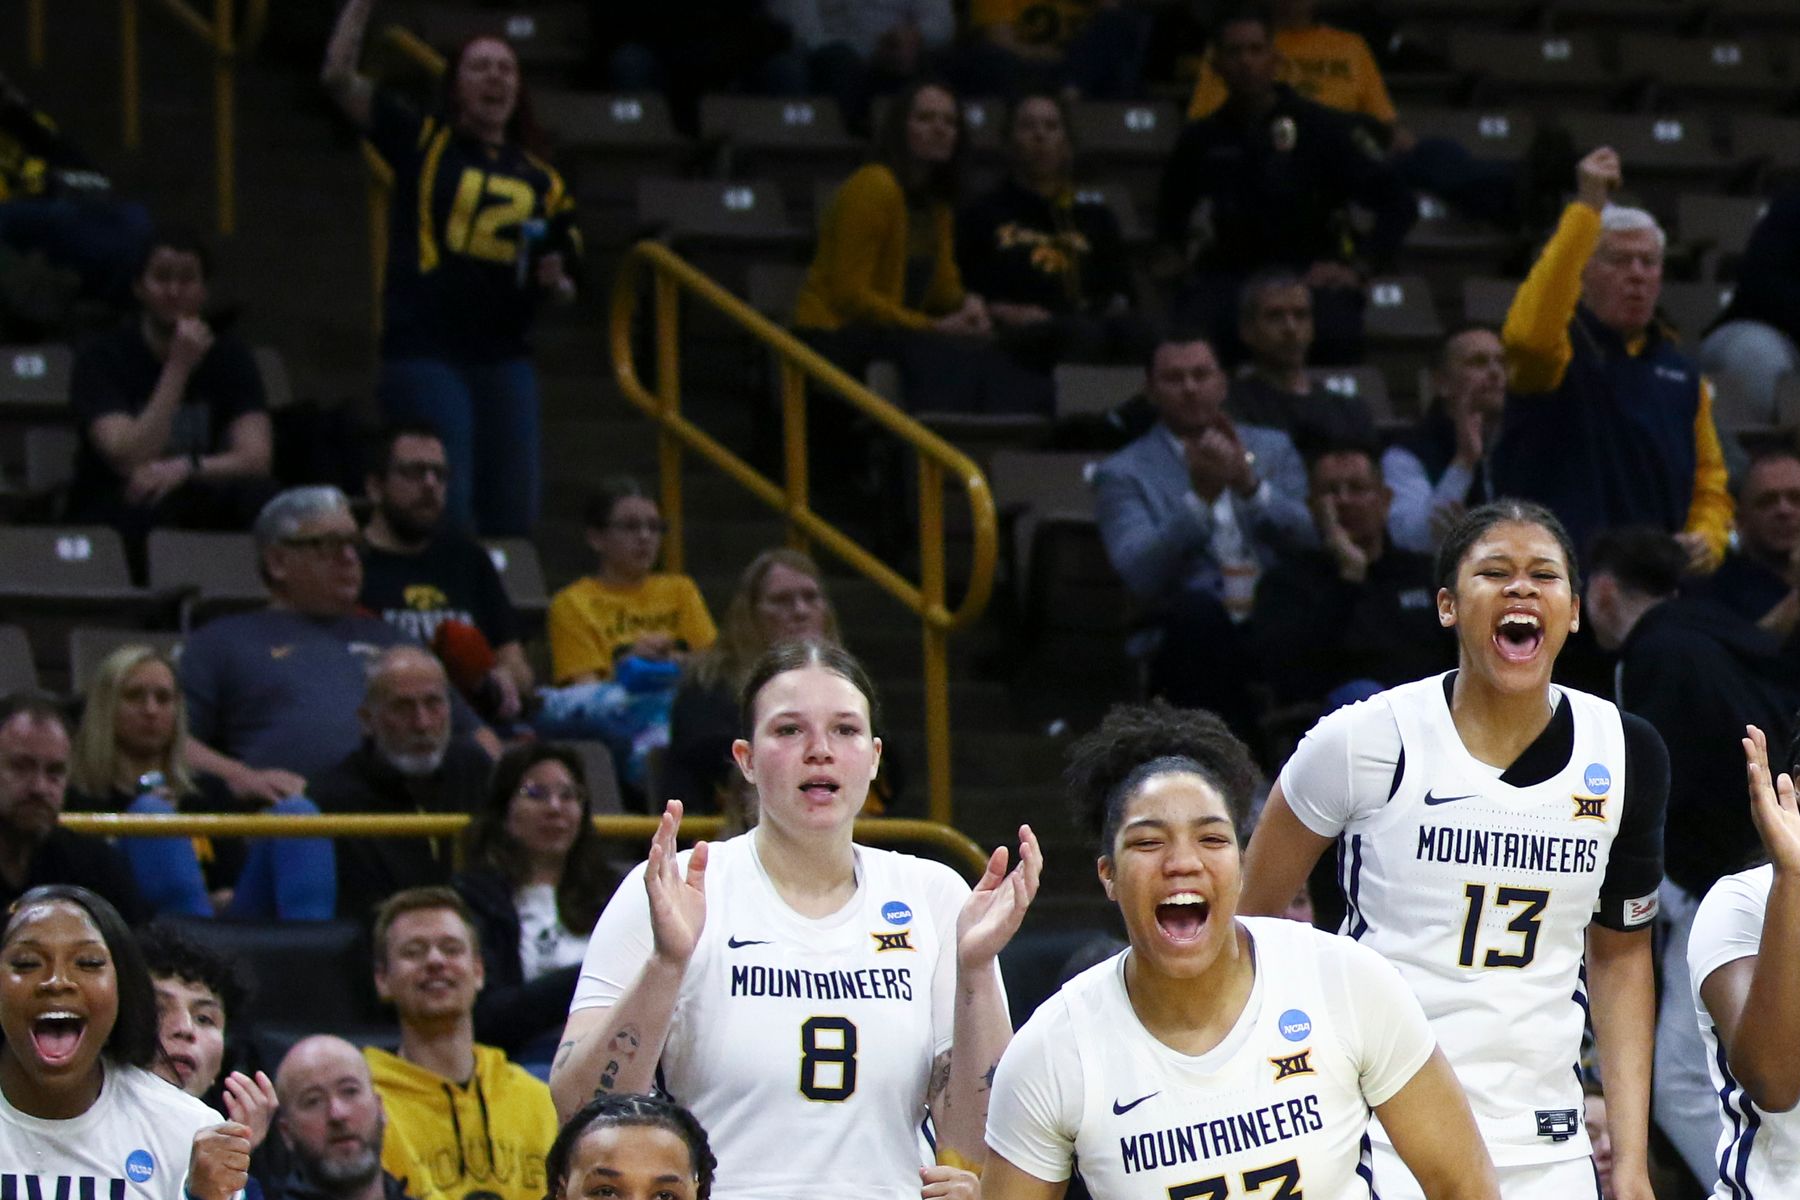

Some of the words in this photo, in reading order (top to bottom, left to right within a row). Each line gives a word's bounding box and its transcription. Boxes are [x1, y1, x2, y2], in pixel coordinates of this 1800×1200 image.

[446, 166, 536, 263] 12
[1416, 825, 1598, 875] MOUNTAINEERS
[1457, 881, 1552, 969] 13
[730, 965, 912, 1002] MOUNTAINEERS
[799, 1016, 858, 1102] 8
[1120, 1094, 1323, 1174] MOUNTAINEERS
